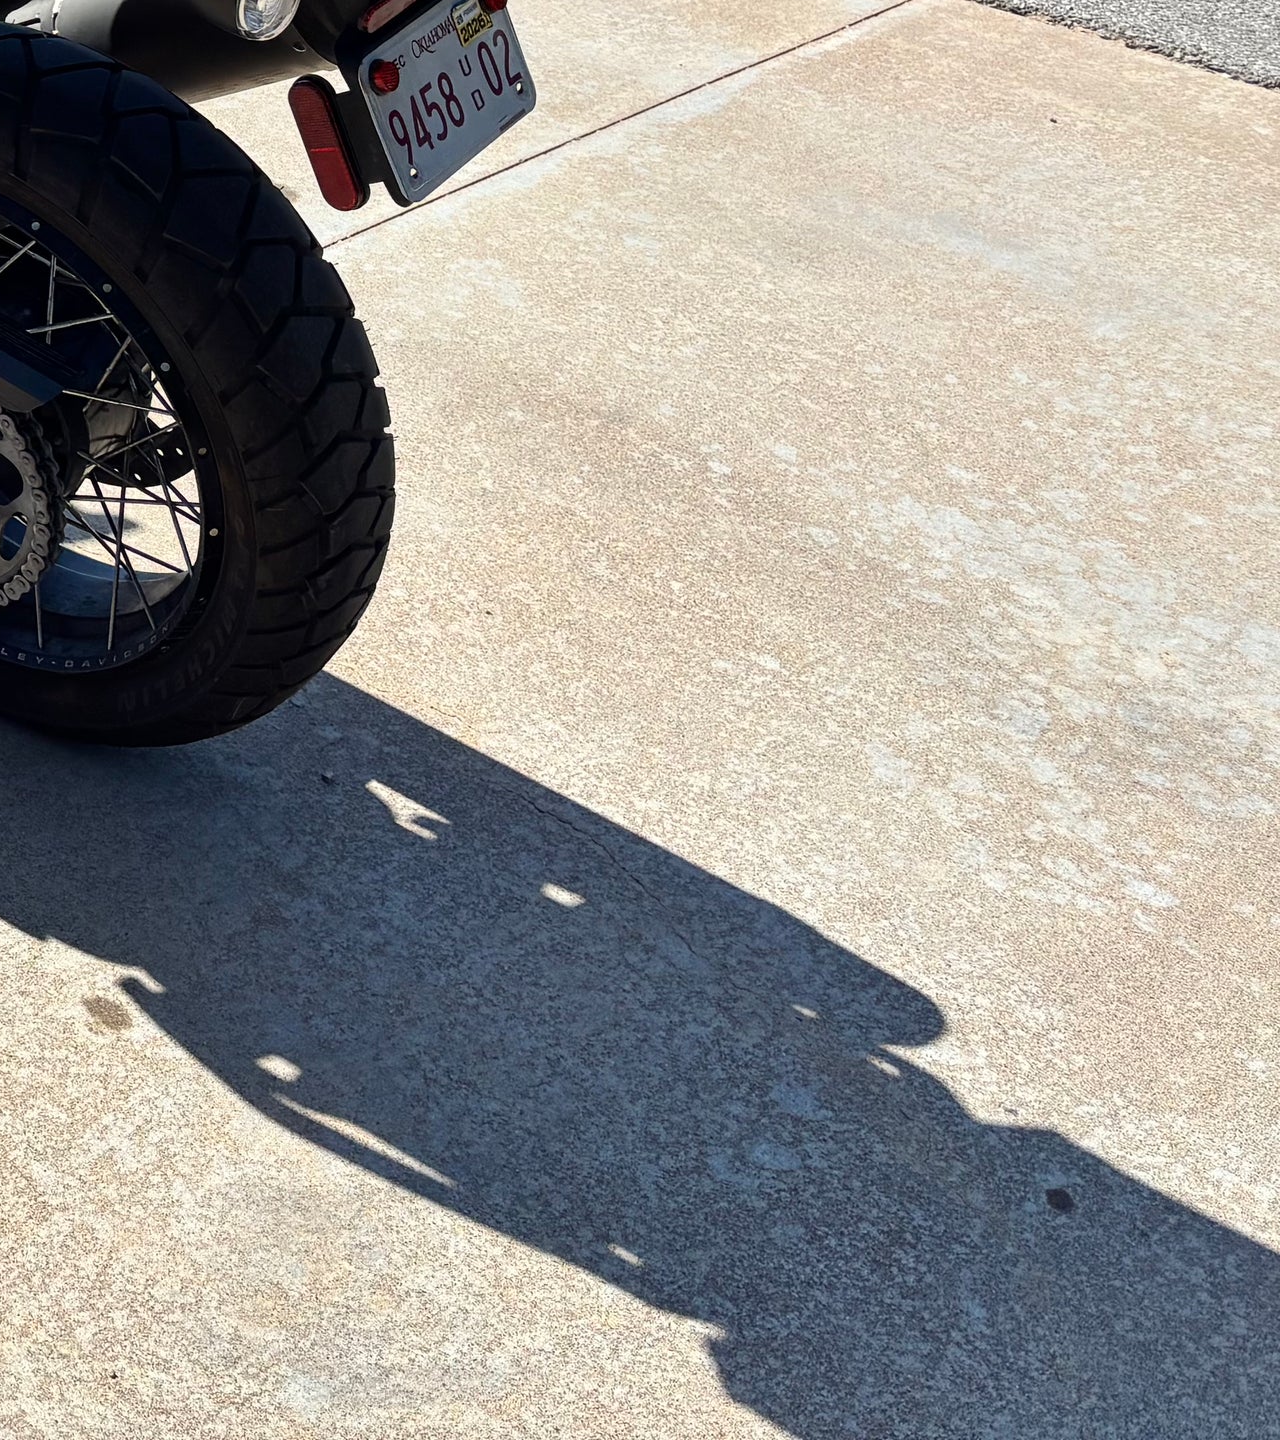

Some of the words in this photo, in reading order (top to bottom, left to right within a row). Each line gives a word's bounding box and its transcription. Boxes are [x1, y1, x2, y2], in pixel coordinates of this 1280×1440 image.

[411, 15, 456, 58] OKLAHOMA
[460, 13, 486, 43] 2026
[388, 71, 465, 165] 9458
[458, 55, 472, 77] U
[477, 29, 524, 97] 02
[117, 597, 238, 712] MICHELIN
